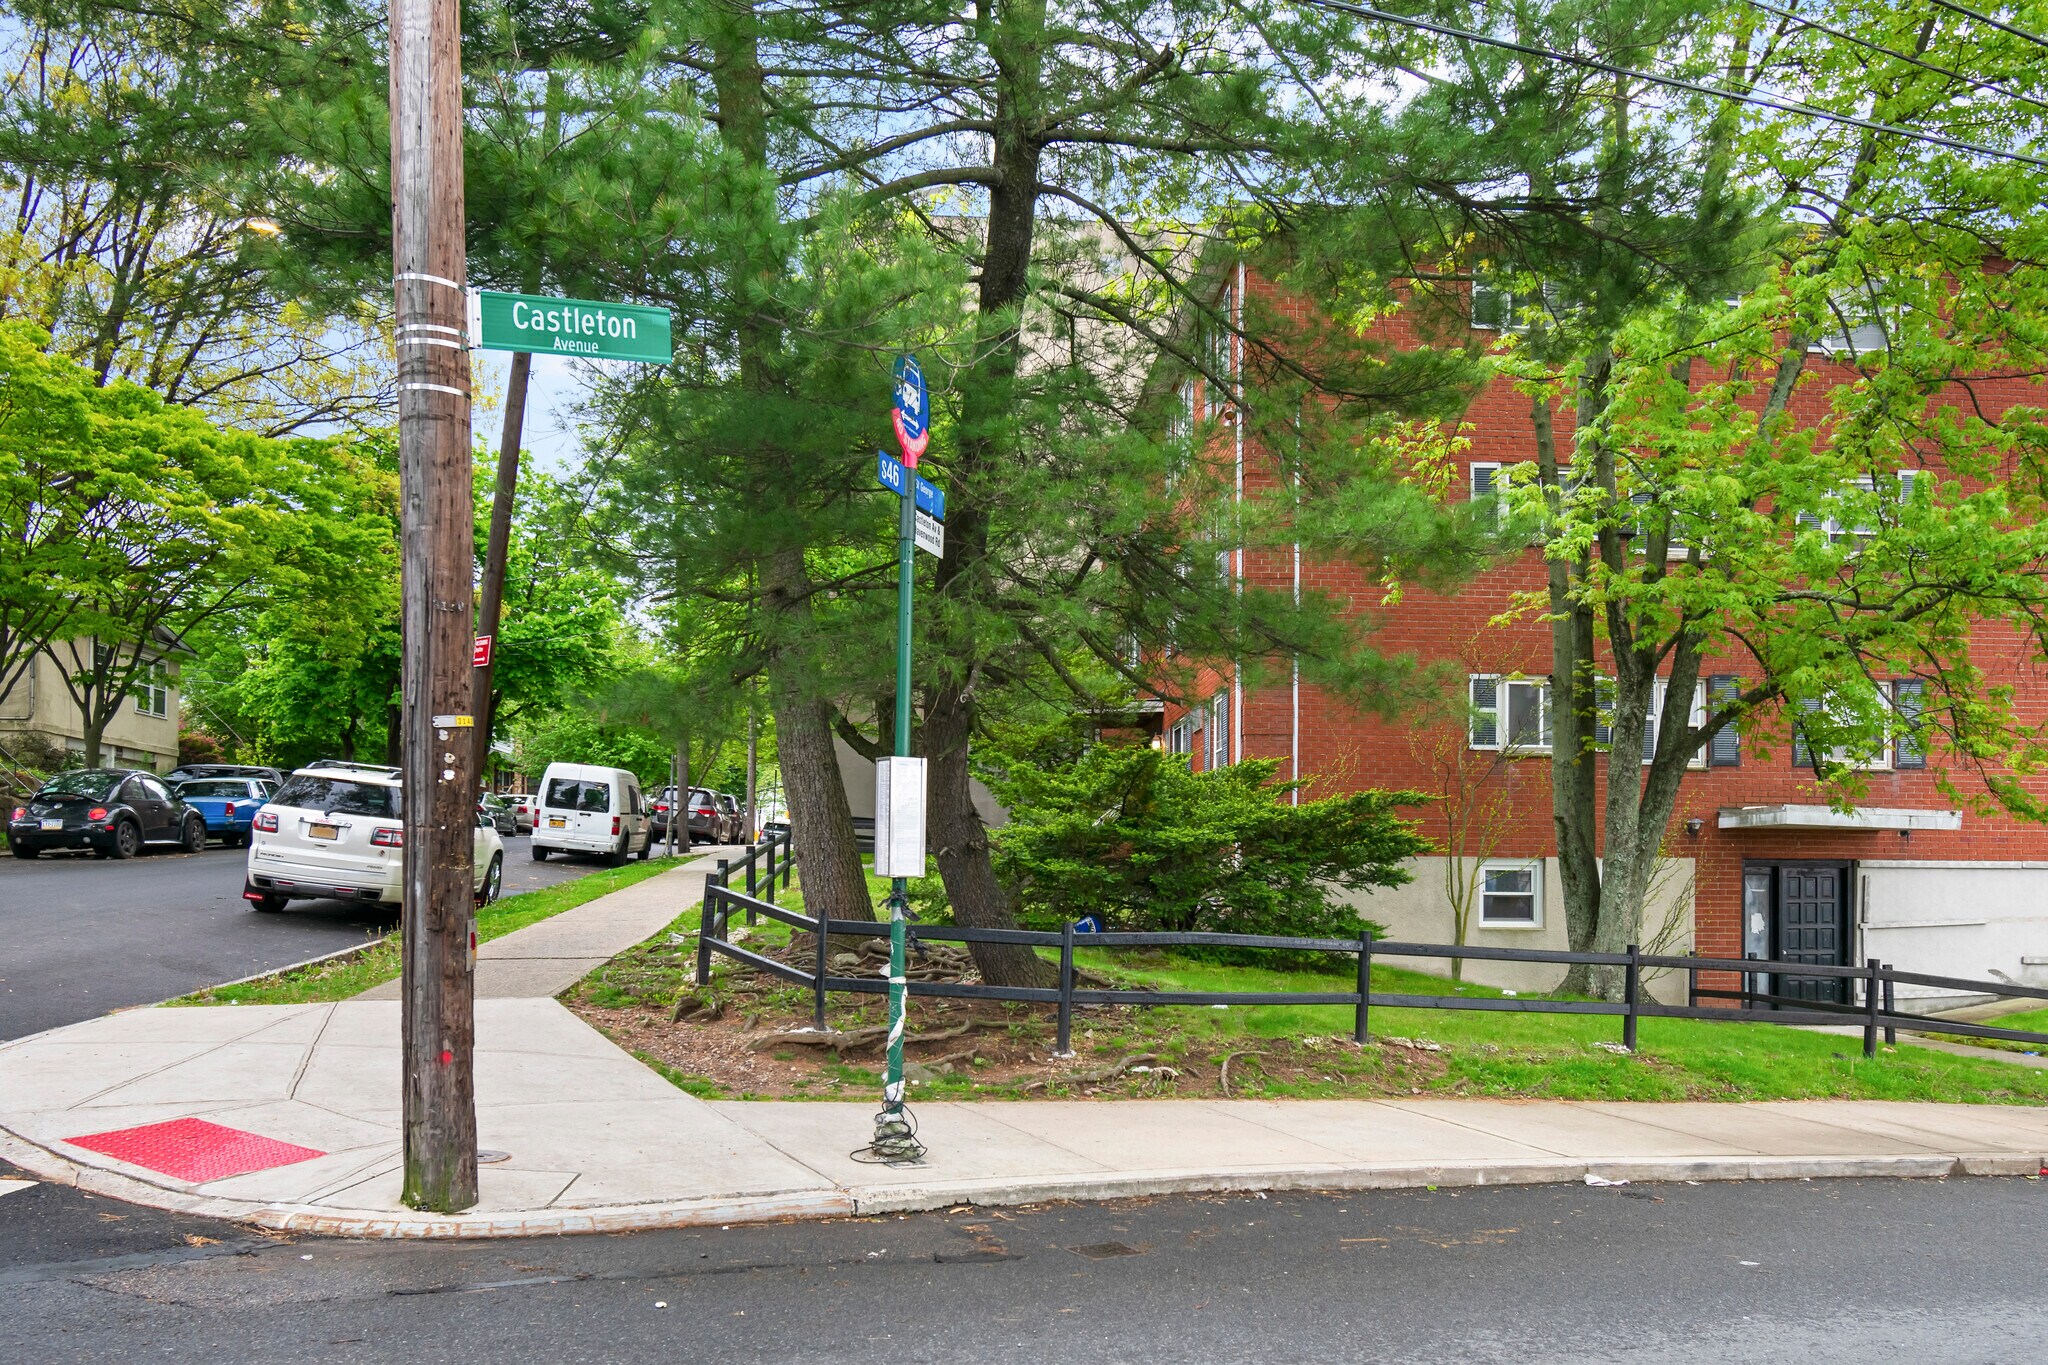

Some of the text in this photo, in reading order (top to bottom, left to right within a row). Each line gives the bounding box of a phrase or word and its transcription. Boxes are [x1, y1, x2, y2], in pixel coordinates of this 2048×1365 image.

[512, 301, 636, 339] Castleton
[553, 336, 599, 353] Avenue
[895, 417, 904, 435] NO
[903, 433, 927, 453] STANDING
[881, 459, 900, 487] S46
[920, 481, 934, 499] George
[916, 514, 932, 530] astleton
[916, 527, 935, 545] avenwood
